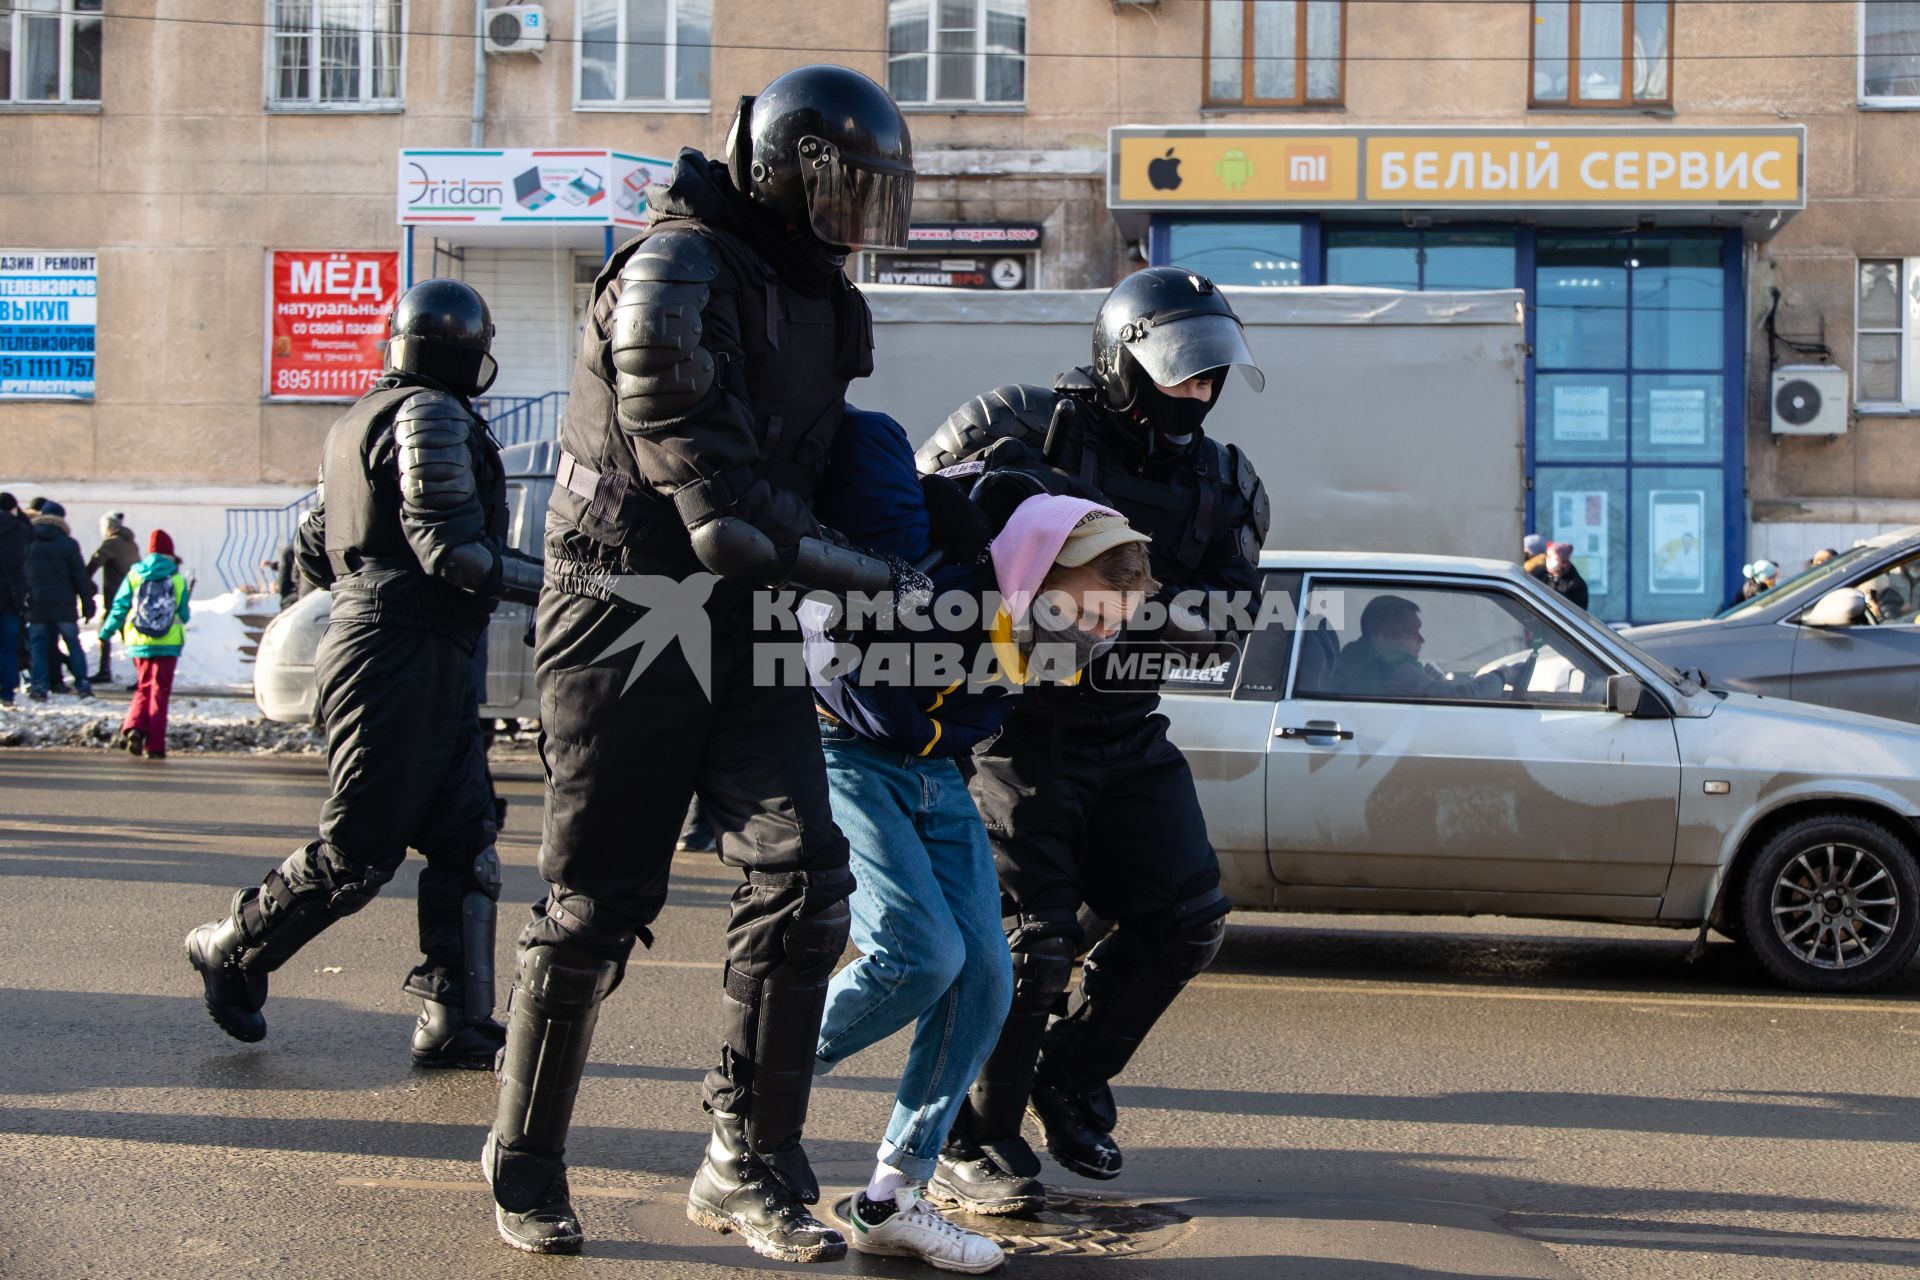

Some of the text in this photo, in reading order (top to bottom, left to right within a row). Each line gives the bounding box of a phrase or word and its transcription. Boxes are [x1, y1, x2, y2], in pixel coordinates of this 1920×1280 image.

[1381, 140, 1781, 190] БЕЛЫЙ СЕРВИС
[908, 229, 951, 241] ТРИЖКА
[0, 256, 96, 271] АЗИН РЕМОНТ
[290, 254, 383, 301] МЁД
[0, 280, 96, 296] ТЕЛЕВИЗОРОВ
[0, 301, 69, 321] ВЫКУП
[292, 322, 307, 335] со
[309, 320, 344, 335] своей
[0, 336, 95, 352] ТЕЛЕВИЗОРОВ
[0, 357, 95, 378] 51 1111 757
[277, 368, 386, 390] 8951111175
